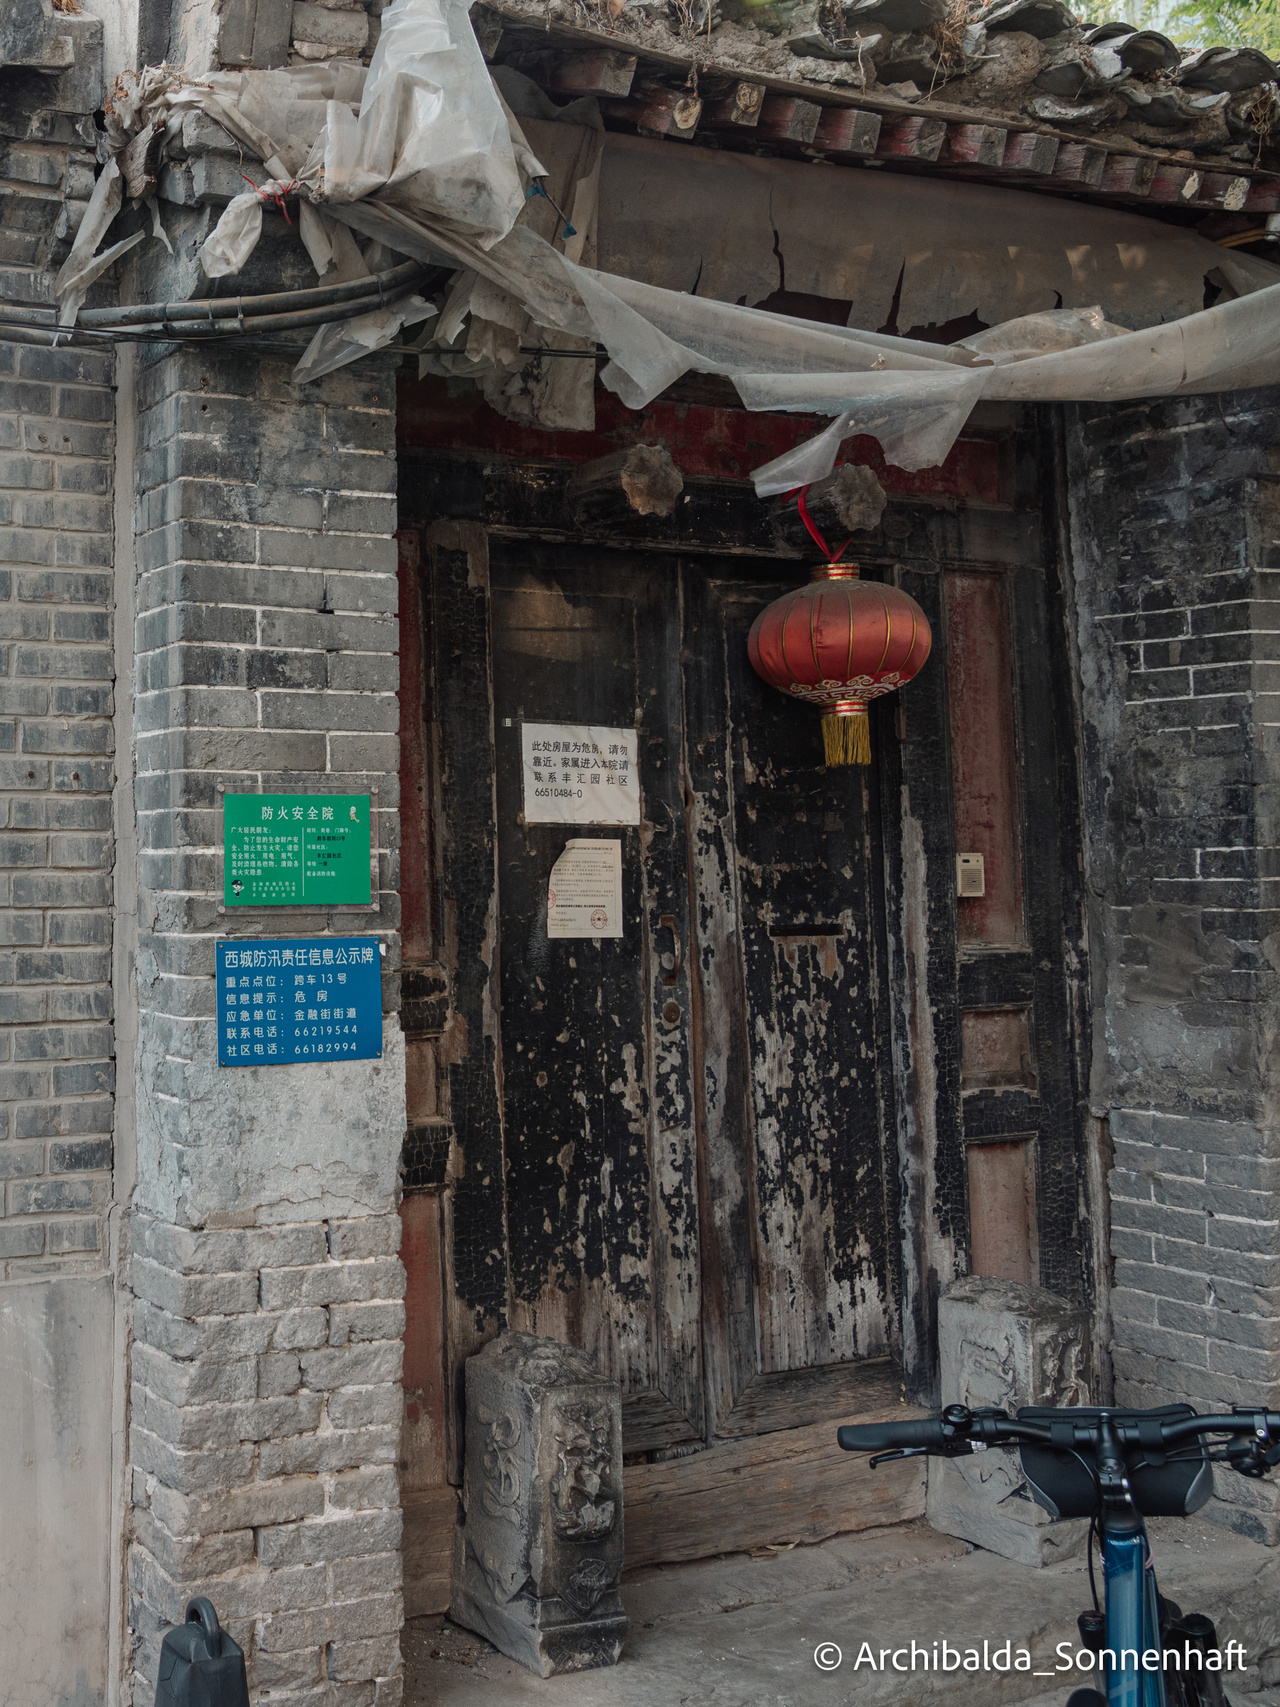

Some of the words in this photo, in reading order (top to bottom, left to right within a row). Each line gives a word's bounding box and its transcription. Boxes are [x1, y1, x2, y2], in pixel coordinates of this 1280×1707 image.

[532, 757, 629, 771] 靠近。家属进入本院请
[534, 772, 628, 786] 联系丰汇园社区
[535, 788, 582, 798] 66510484-0
[261, 806, 334, 820] 防火安全院
[225, 947, 374, 968] 西城防汛责任信息公示牌
[226, 975, 283, 988] 重点点位：
[226, 992, 284, 1005] 信息提示：
[226, 1010, 284, 1022] 应急单位：
[294, 1008, 356, 1021] 金融街街道
[226, 1026, 284, 1039] 联系电话：
[295, 1025, 357, 1037] 66219544
[227, 1043, 285, 1056] 社区电话：
[295, 1043, 356, 1054] 66182994
